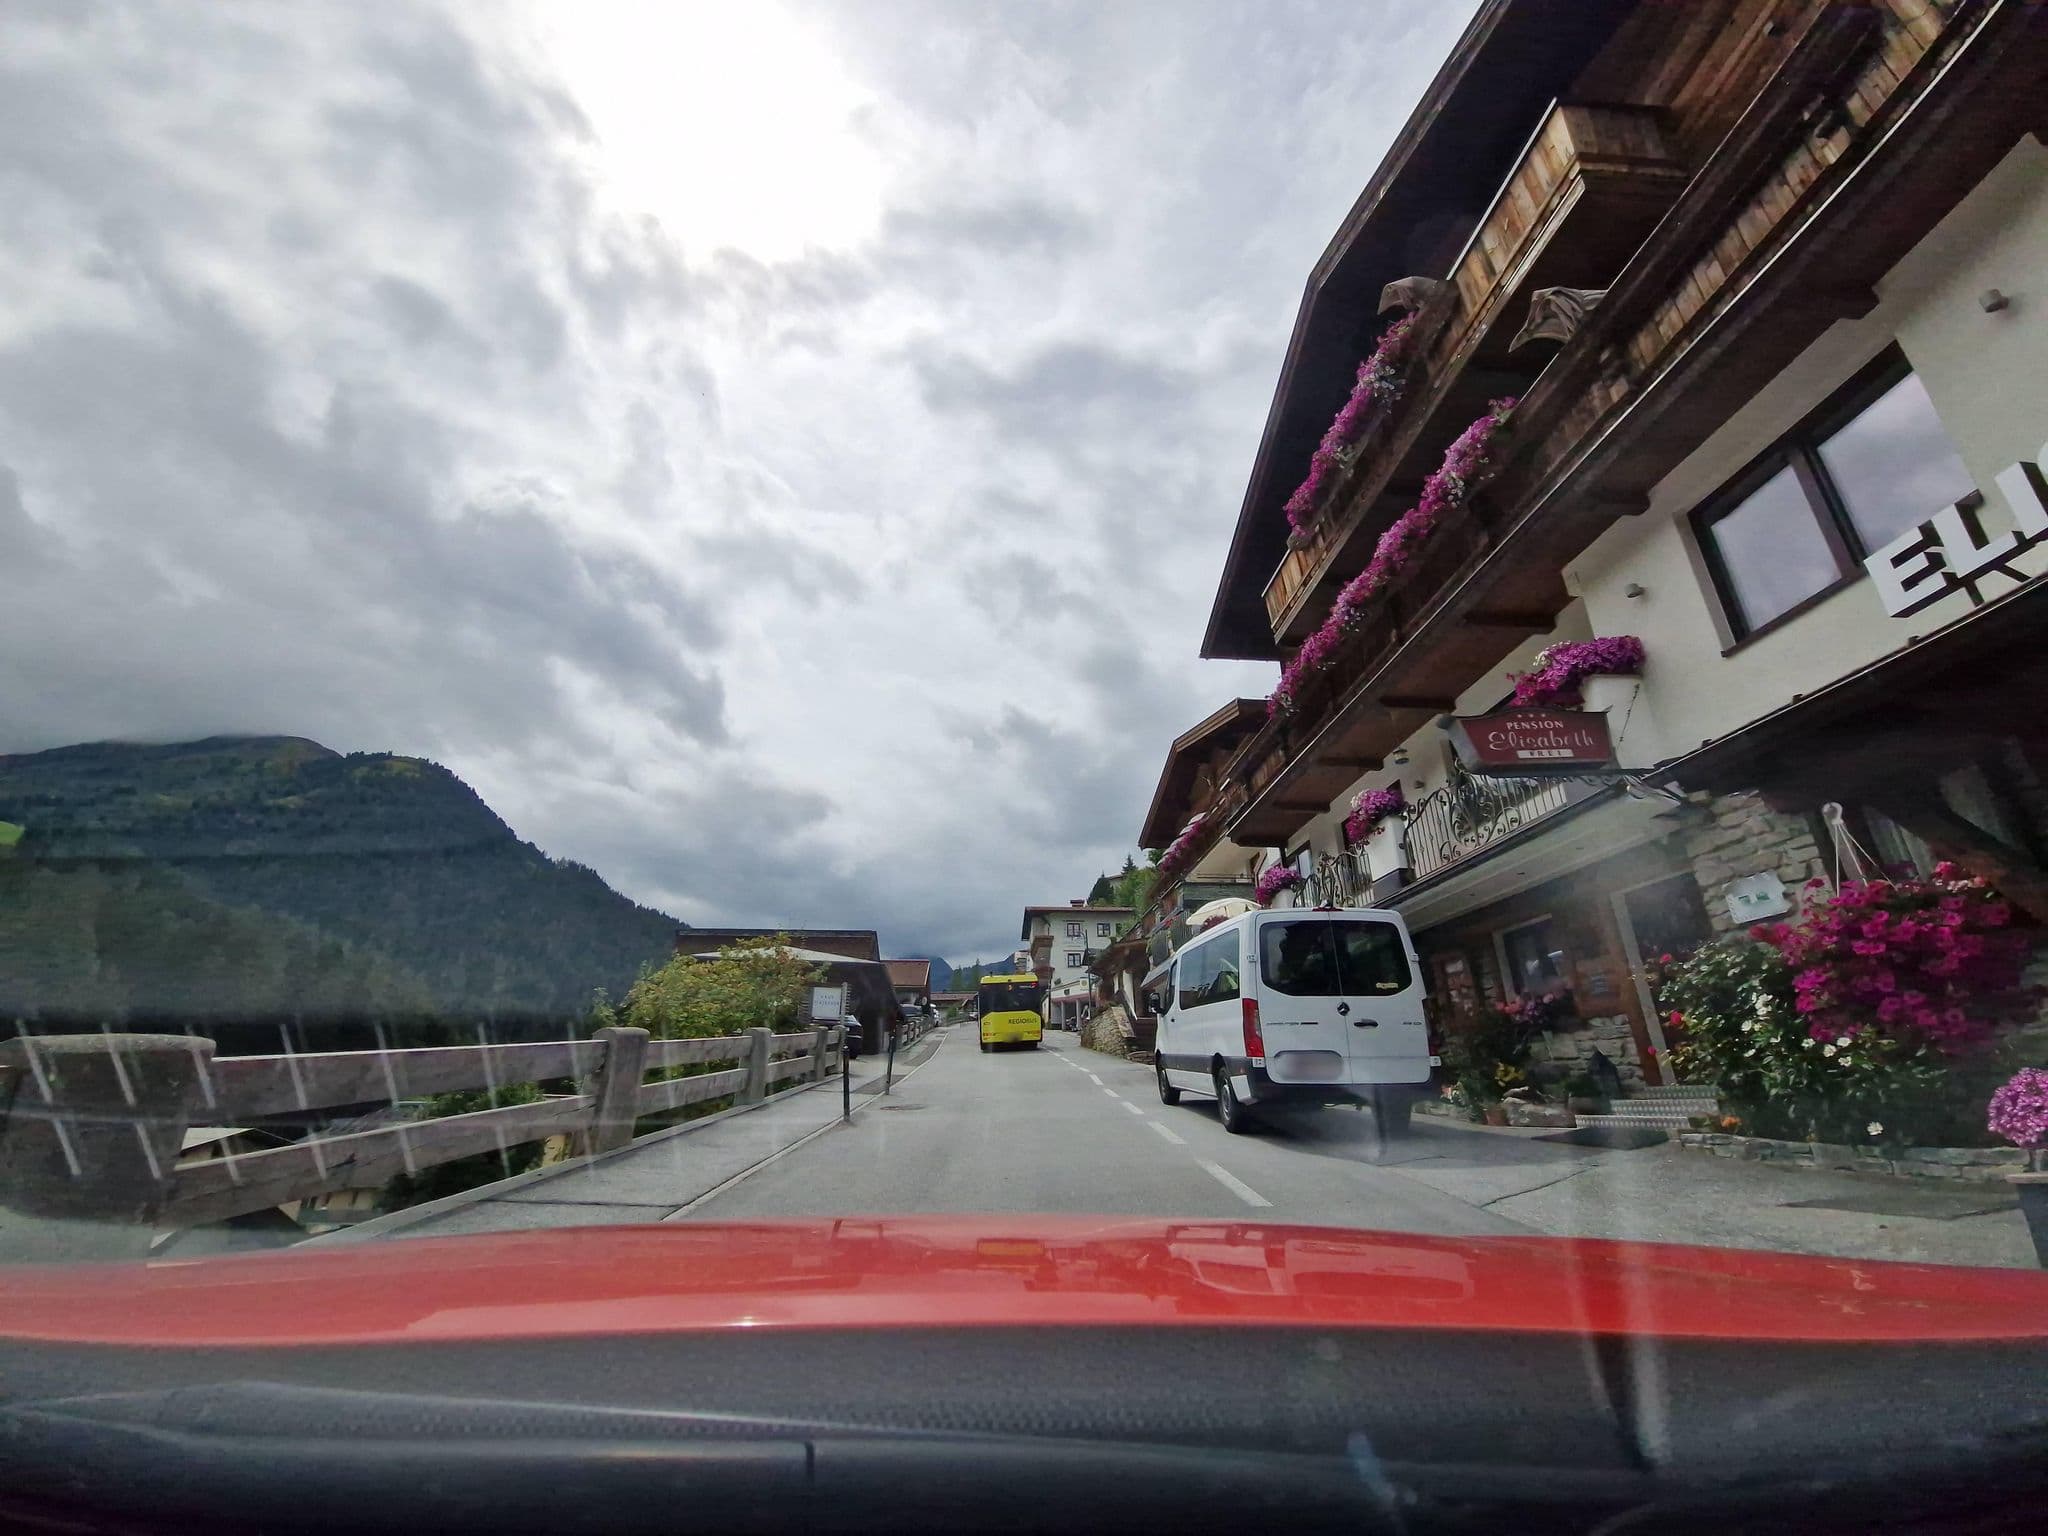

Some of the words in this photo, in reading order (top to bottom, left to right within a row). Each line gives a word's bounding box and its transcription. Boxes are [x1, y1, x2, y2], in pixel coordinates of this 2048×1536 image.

[1863, 439, 2048, 617] ELI
[1506, 720, 1565, 731] PENSION
[1488, 729, 1595, 751] Elisabeth
